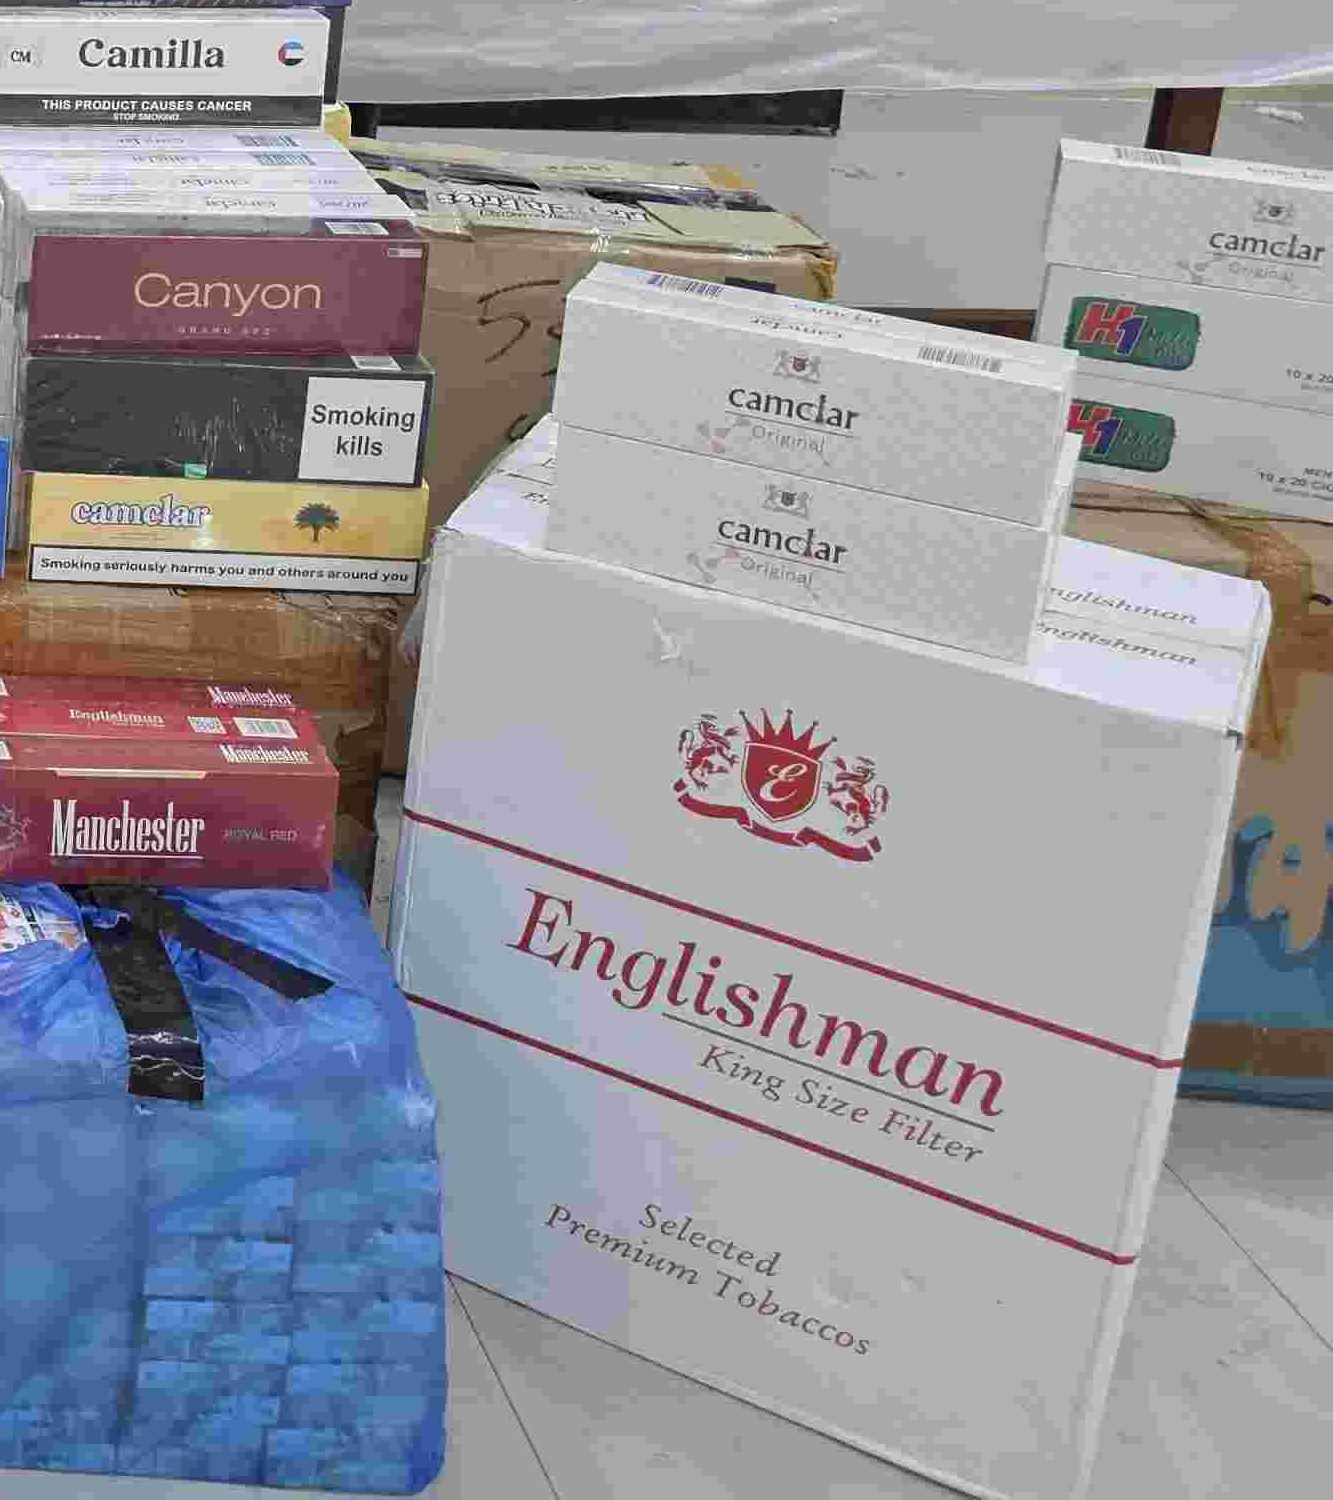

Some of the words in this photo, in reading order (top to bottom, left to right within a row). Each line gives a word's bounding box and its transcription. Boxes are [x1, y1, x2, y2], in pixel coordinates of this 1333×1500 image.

[9, 49, 32, 64] CM
[77, 37, 225, 71] Camilla
[42, 99, 69, 111] THIS
[72, 100, 133, 112] PRODUCT
[136, 101, 192, 112] CAUSES
[194, 101, 252, 113] CANCER
[112, 112, 135, 121] STOP
[1209, 229, 1326, 264] camclar
[133, 272, 323, 316] Canyon
[311, 404, 415, 432] Smoking
[728, 382, 860, 434] camclar
[335, 436, 383, 457] kills
[751, 423, 828, 455] Original
[71, 493, 211, 529] camclar
[716, 513, 849, 566] camclar
[41, 558, 101, 572] Smoking
[104, 560, 166, 574] seriously
[171, 562, 215, 575] harms
[218, 565, 245, 576] you
[248, 564, 274, 577] and
[278, 566, 324, 579] others
[327, 568, 378, 581] around
[382, 571, 408, 583] you
[738, 555, 816, 586] Original
[1049, 587, 1198, 626] nglishman
[51, 799, 207, 854] Manchester
[223, 828, 265, 842] ROYAL
[269, 830, 298, 843] RED
[505, 886, 1007, 1120] Englishman
[699, 1043, 786, 1104] King
[793, 1077, 870, 1127] Size
[879, 1108, 986, 1167] Filter
[638, 1203, 784, 1279] Selected
[544, 1204, 702, 1288] Premium
[714, 1269, 873, 1358] Tobaccos
